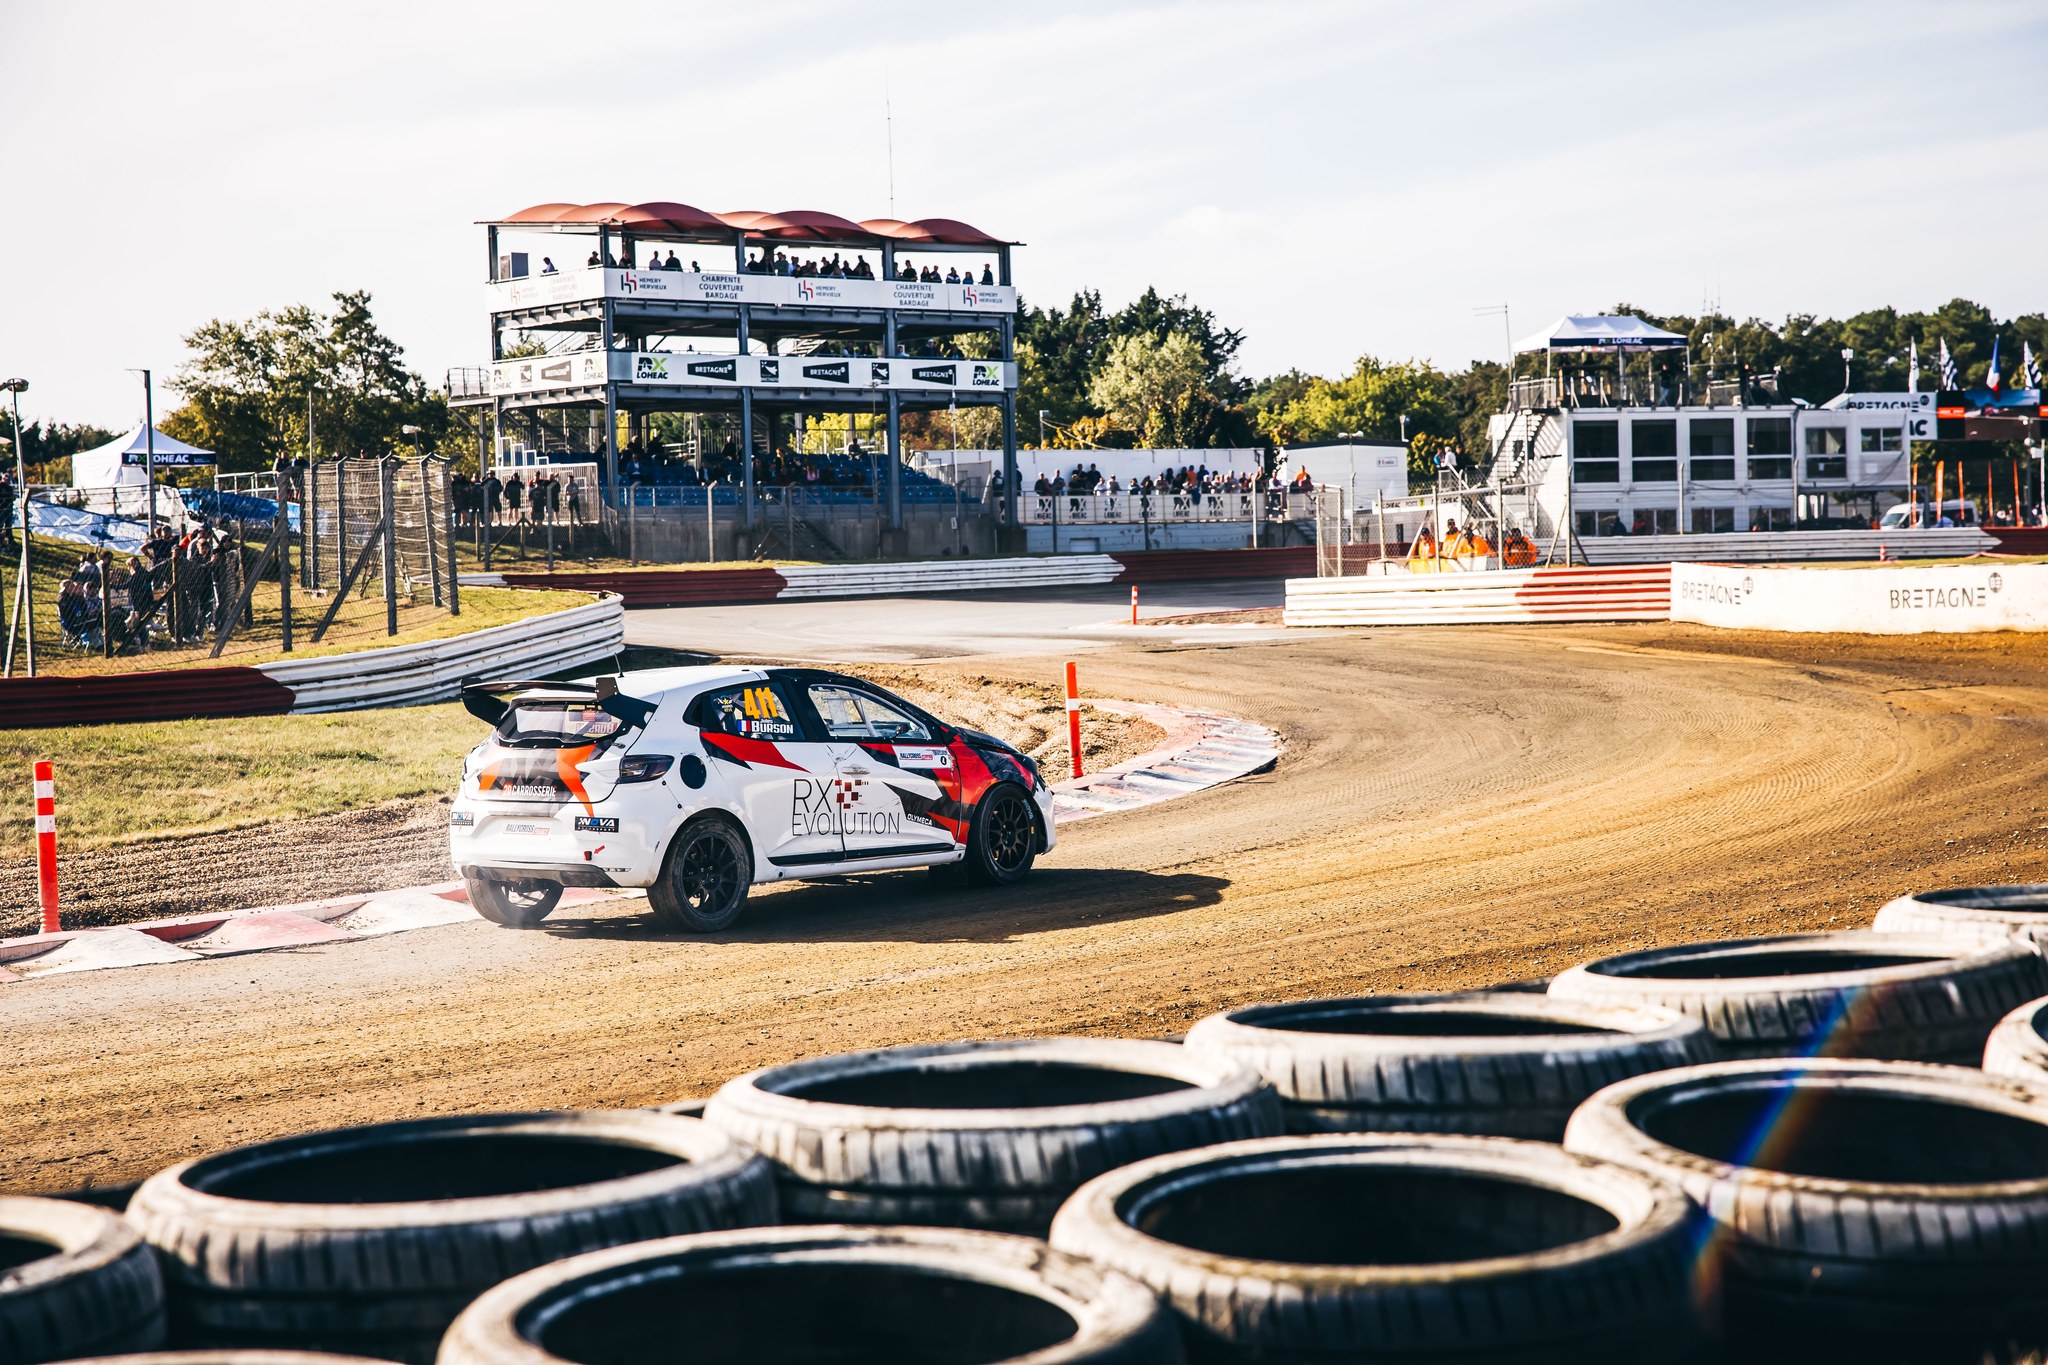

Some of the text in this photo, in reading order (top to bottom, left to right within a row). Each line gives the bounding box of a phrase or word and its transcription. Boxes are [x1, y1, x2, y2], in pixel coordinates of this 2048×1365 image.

[701, 275, 741, 284] CHARPENTE
[639, 283, 667, 291] HERVIEUX
[699, 283, 744, 292] COUVERTURE
[895, 283, 932, 292] CHARPENTE
[705, 291, 739, 300] BARDAGE
[893, 291, 935, 300] COUVERTURE
[899, 299, 929, 307] BARDAGE
[1612, 337, 1643, 345] LOHEAC
[638, 357, 667, 371] RX
[695, 365, 728, 373] BRETAGNE
[810, 368, 841, 376] BRETAGNE
[973, 365, 999, 379] RX
[636, 371, 669, 380] LOHEAC
[153, 454, 189, 463] OHEAC
[1682, 581, 1741, 605] BRETAGNE
[1890, 588, 1986, 609] BRETAGNE
[743, 687, 779, 719] 411
[751, 720, 794, 734] BURSON
[512, 785, 557, 797] CARROSSERIE
[793, 779, 834, 813] RX
[582, 817, 615, 827] NOVA
[792, 812, 900, 837] EVOLUTION
